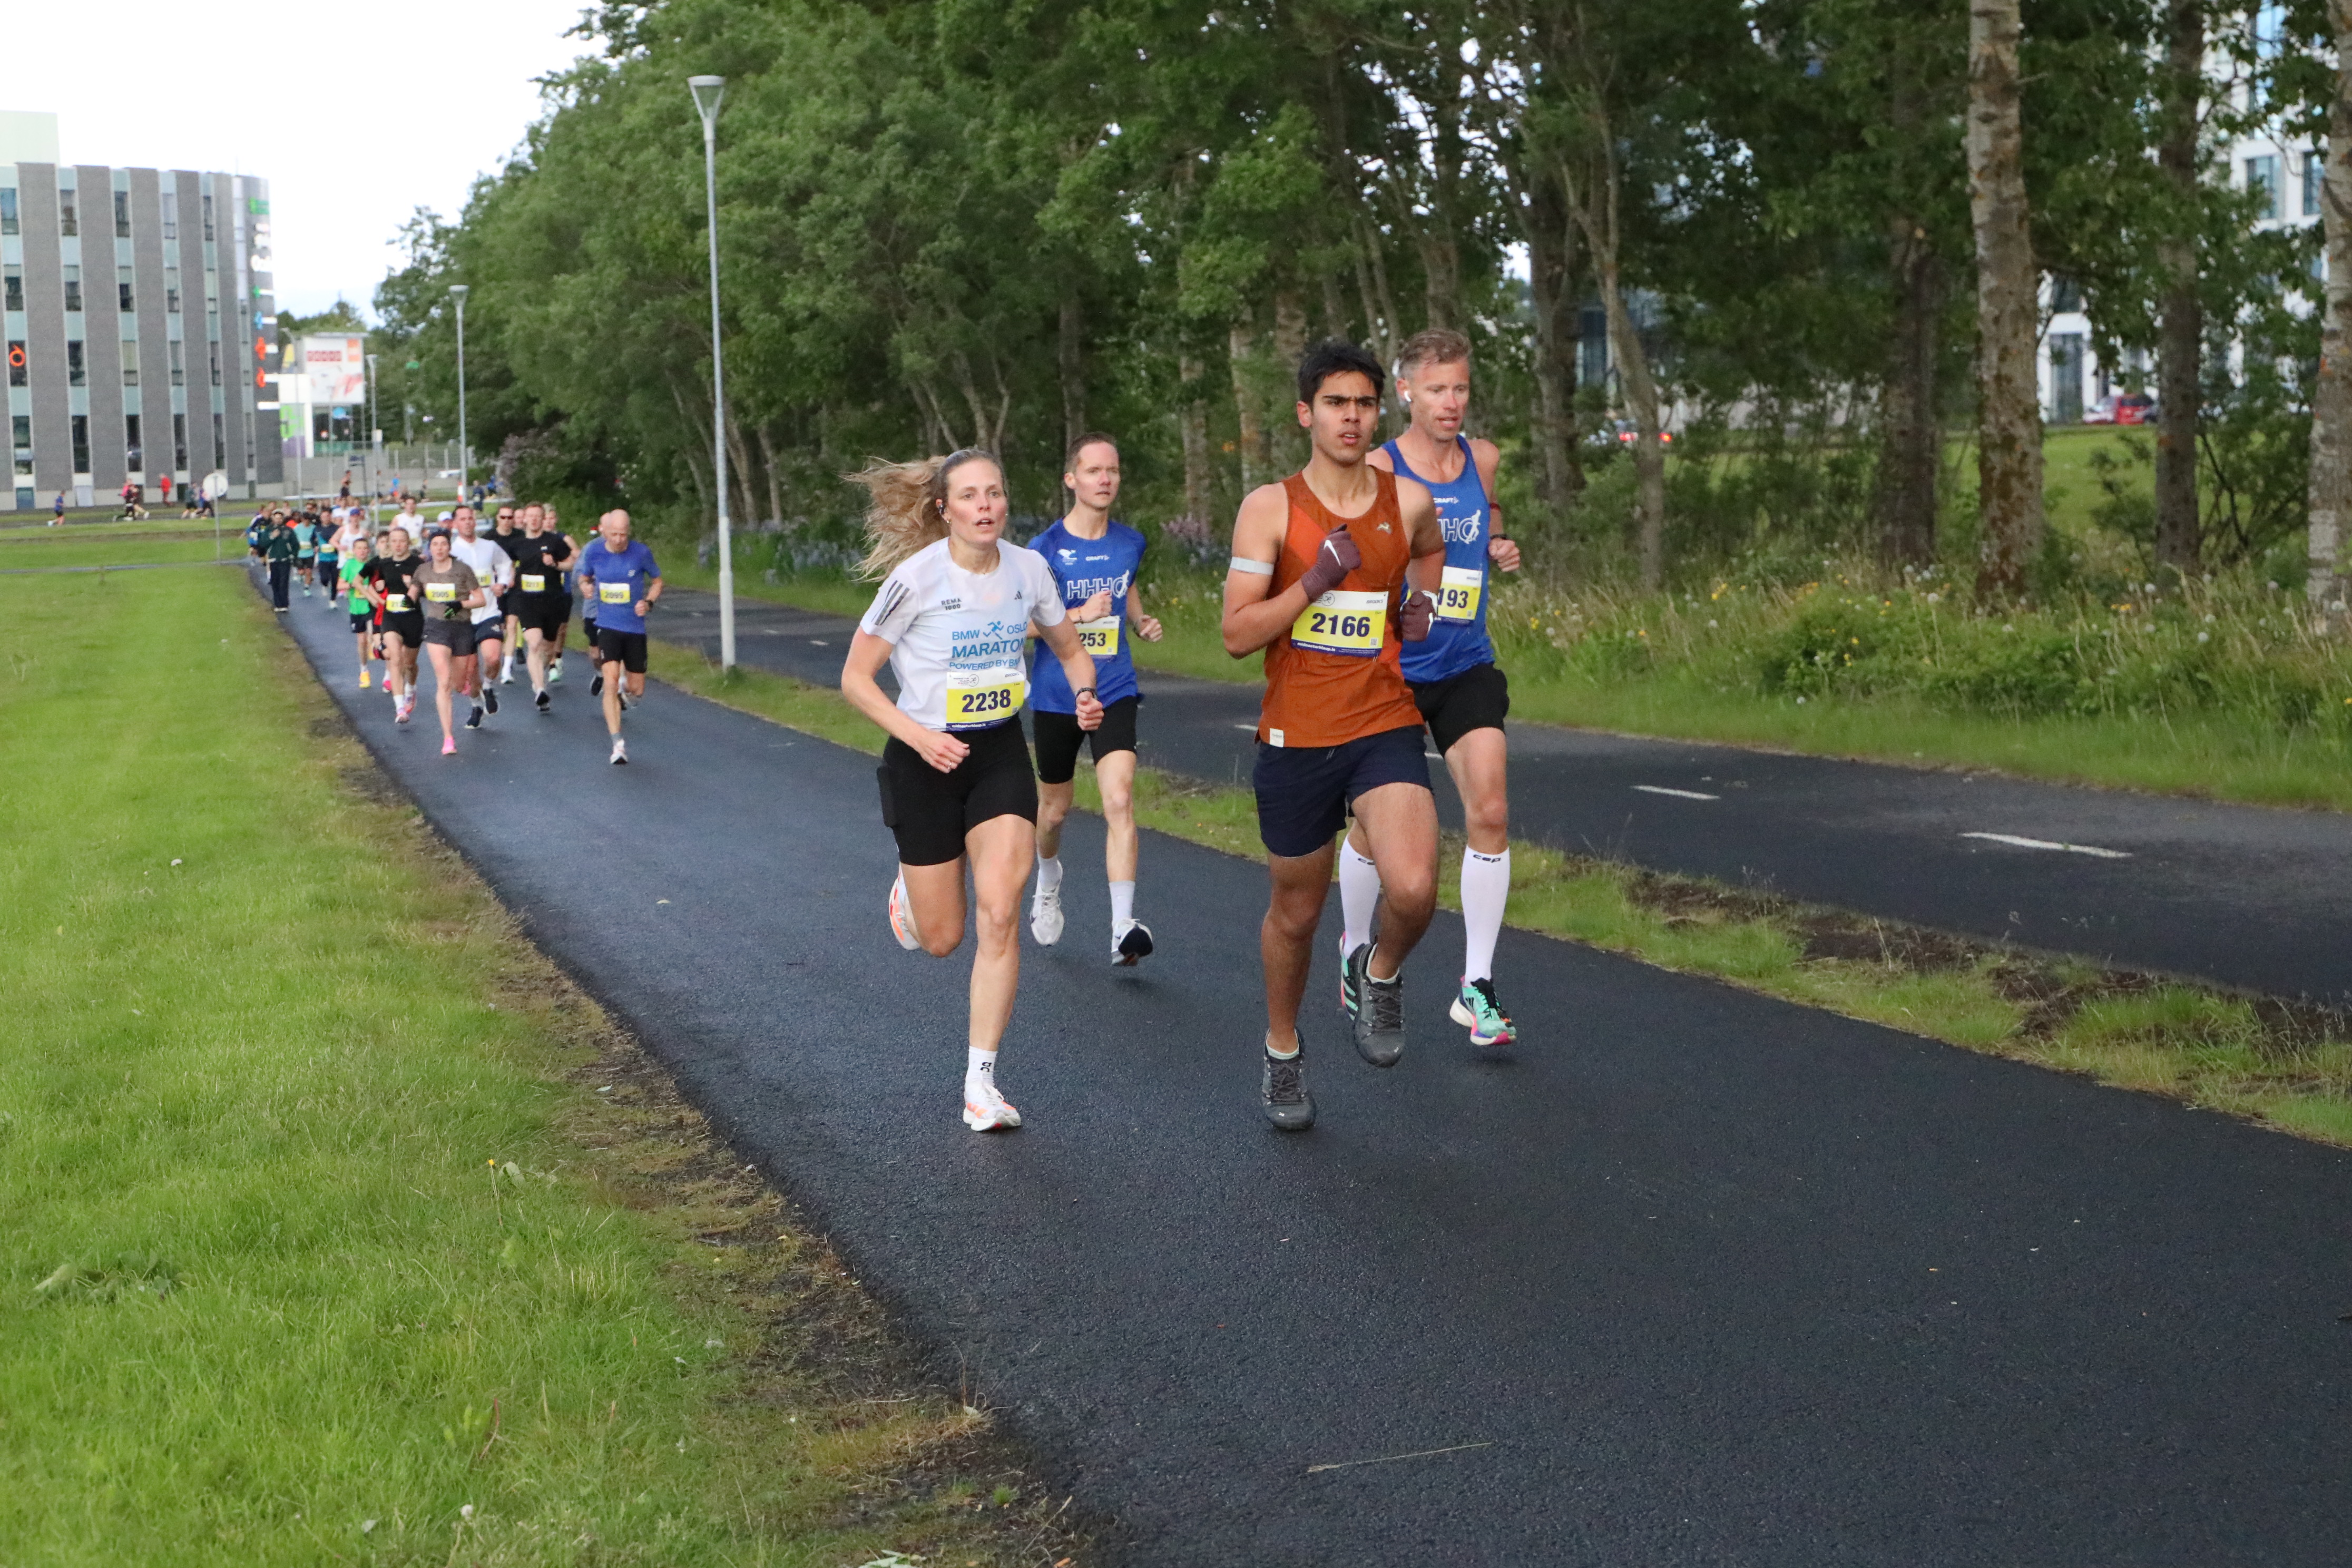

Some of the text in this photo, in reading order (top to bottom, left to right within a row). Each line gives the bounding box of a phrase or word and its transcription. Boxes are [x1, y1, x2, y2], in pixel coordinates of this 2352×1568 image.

[952, 622, 1027, 640] BMW OSLO
[1310, 613, 1370, 637] 2166
[949, 661, 994, 670] POWERED
[962, 689, 1011, 712] 2238
[1473, 854, 1501, 863] cep
